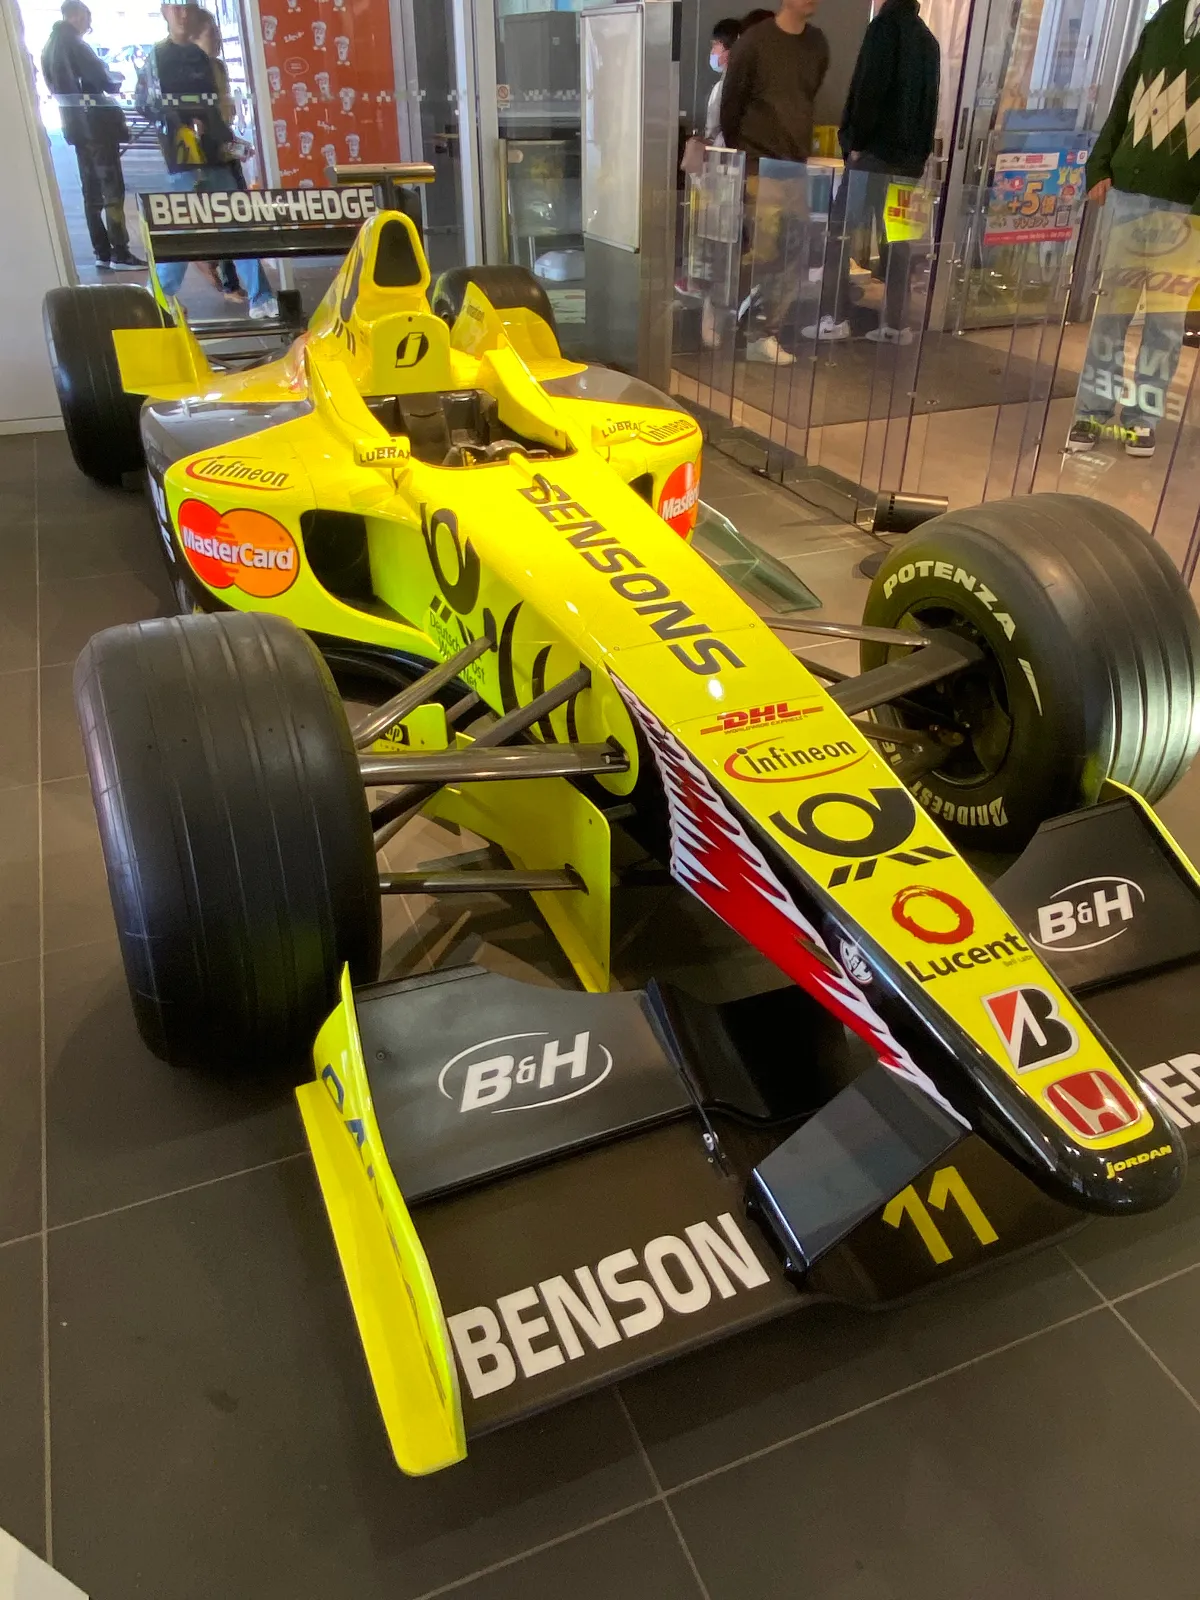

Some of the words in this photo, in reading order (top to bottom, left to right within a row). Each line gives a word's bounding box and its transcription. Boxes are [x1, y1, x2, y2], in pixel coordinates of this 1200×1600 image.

[149, 192, 276, 225] BENSON
[182, 526, 294, 571] MasterCard
[883, 560, 1017, 642] POTENZA
[716, 702, 802, 731] DHL
[1037, 883, 1134, 944] B&H
[905, 932, 1029, 983] Lucent
[460, 1031, 590, 1114] B&H
[1106, 1144, 1173, 1180] JORDAN
[882, 1165, 1000, 1265] 11
[447, 1212, 771, 1399] BENSON
